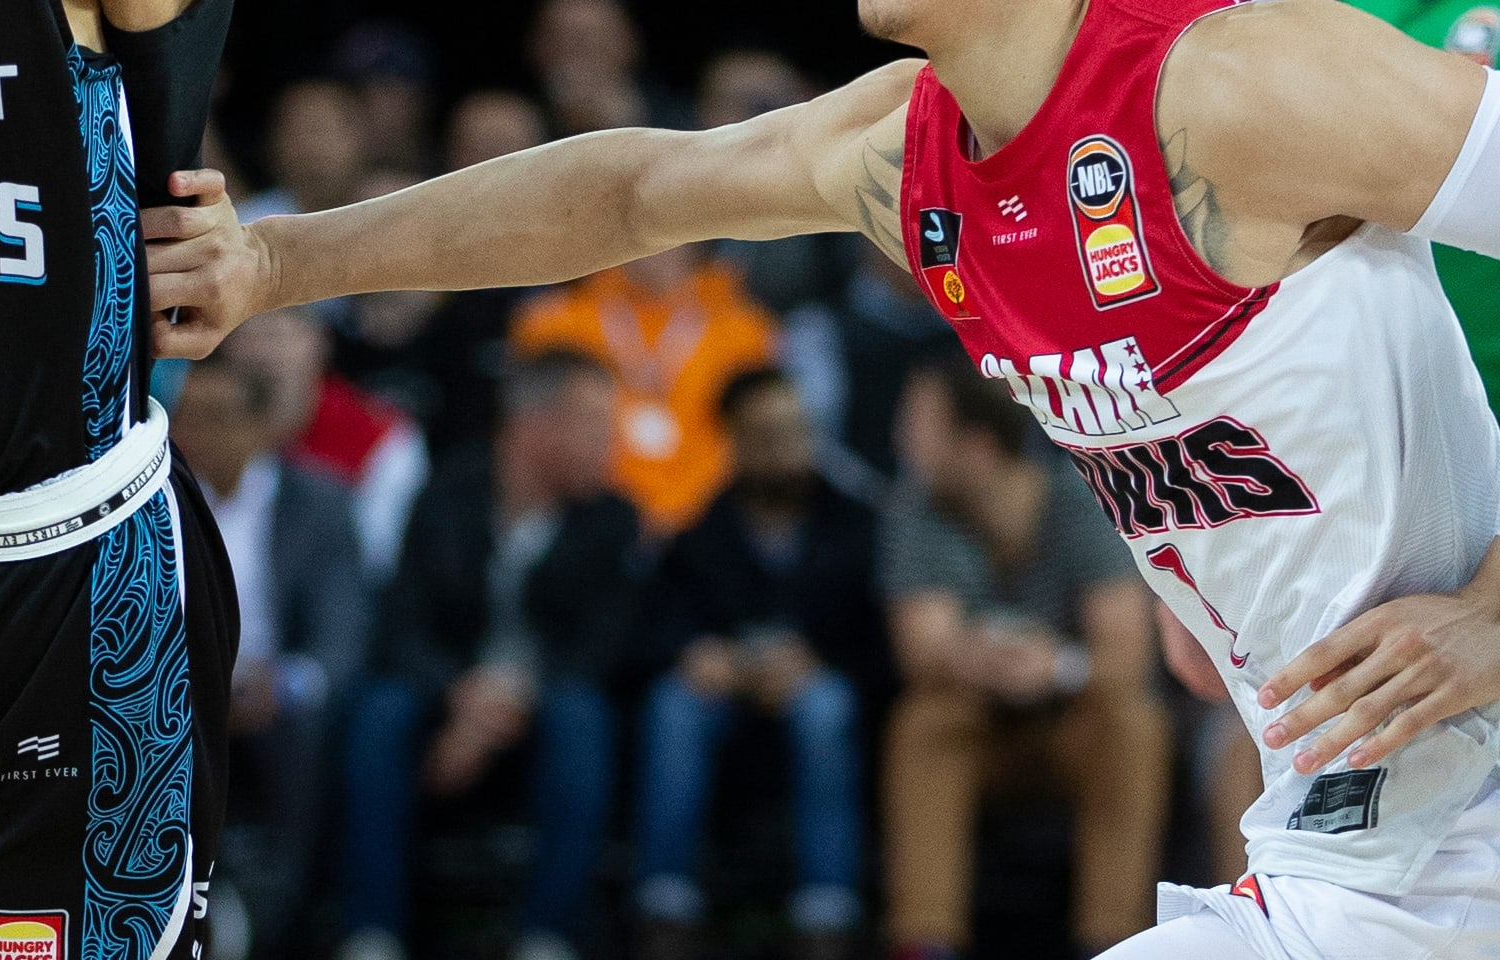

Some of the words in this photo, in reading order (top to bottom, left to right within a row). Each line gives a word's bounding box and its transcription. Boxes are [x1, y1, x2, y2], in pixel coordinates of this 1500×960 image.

[1077, 161, 1116, 198] NBL
[992, 232, 1017, 246] FIRST
[1019, 227, 1038, 241] EVER
[1089, 241, 1135, 263] HUNGRY
[45, 767, 79, 778] EVER
